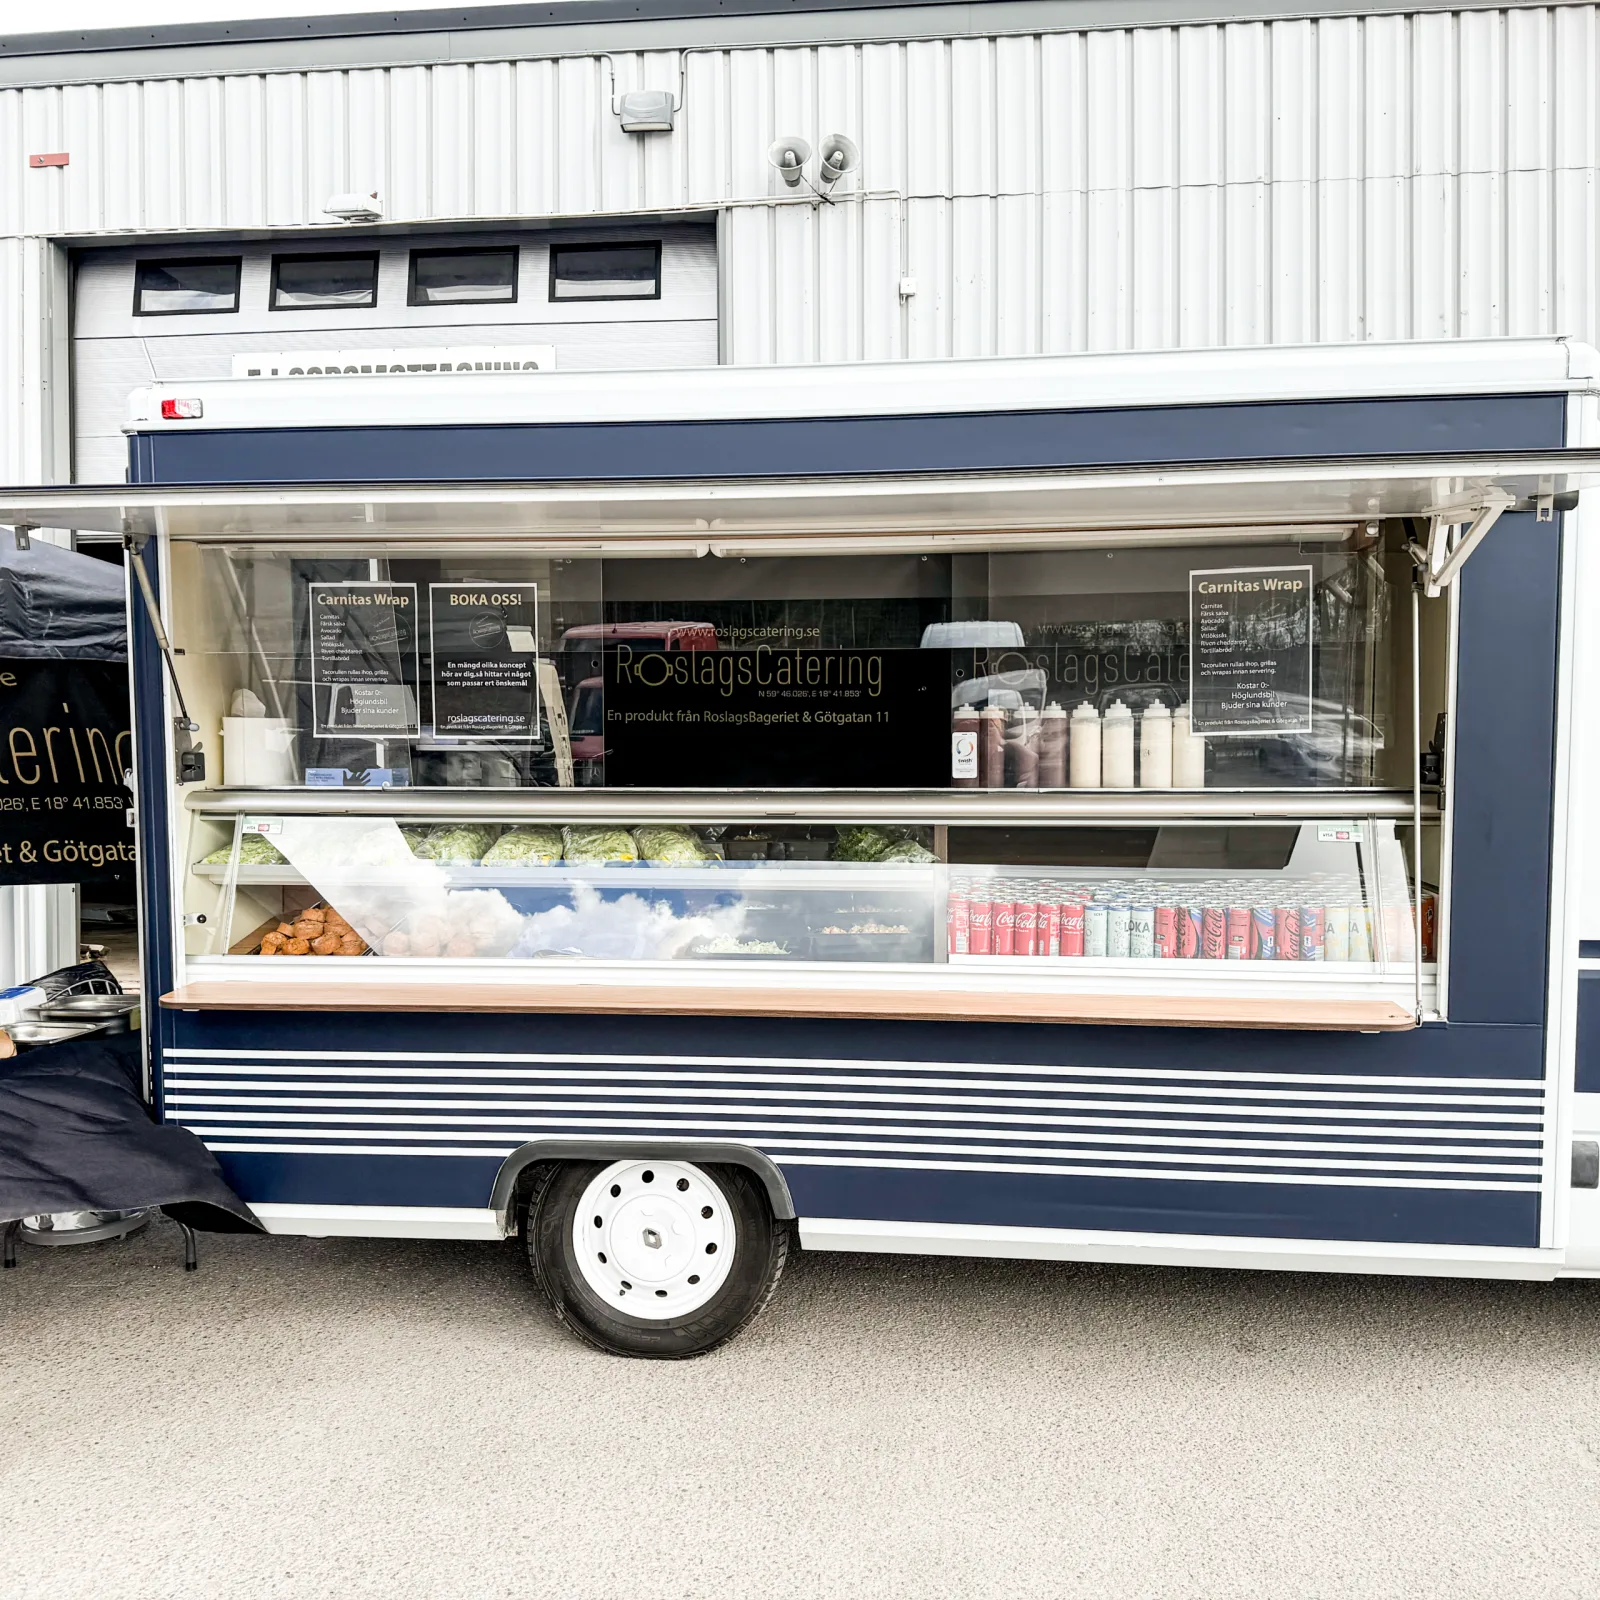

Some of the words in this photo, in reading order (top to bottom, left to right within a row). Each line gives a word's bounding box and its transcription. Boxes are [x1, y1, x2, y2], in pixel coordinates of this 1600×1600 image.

[1198, 580, 1260, 594] Carnitas
[1262, 578, 1302, 592] Wrap
[317, 594, 371, 605] Carnitas
[374, 594, 409, 608] Wrap
[450, 594, 488, 606] BOKA
[491, 594, 522, 606] OSS!
[676, 625, 820, 639] www.roslagscatering.se
[617, 644, 882, 697] RoslagsCatering
[973, 643, 1190, 694] RoslagsCate
[350, 698, 388, 706] Höglundsbil
[1231, 691, 1275, 700] Höglundsbil
[1221, 702, 1245, 710] Bjuder
[448, 713, 525, 724] roslagscatering.se
[607, 710, 622, 721] En
[625, 710, 673, 724] produkt
[677, 710, 700, 722] från
[704, 711, 799, 725] RoslagsBageriet
[802, 711, 812, 723] &
[814, 711, 872, 725] Götgatan
[876, 711, 889, 722] 11
[0, 703, 132, 785] erin
[31, 798, 41, 810] E
[45, 797, 68, 809] 18°
[19, 840, 38, 863] &
